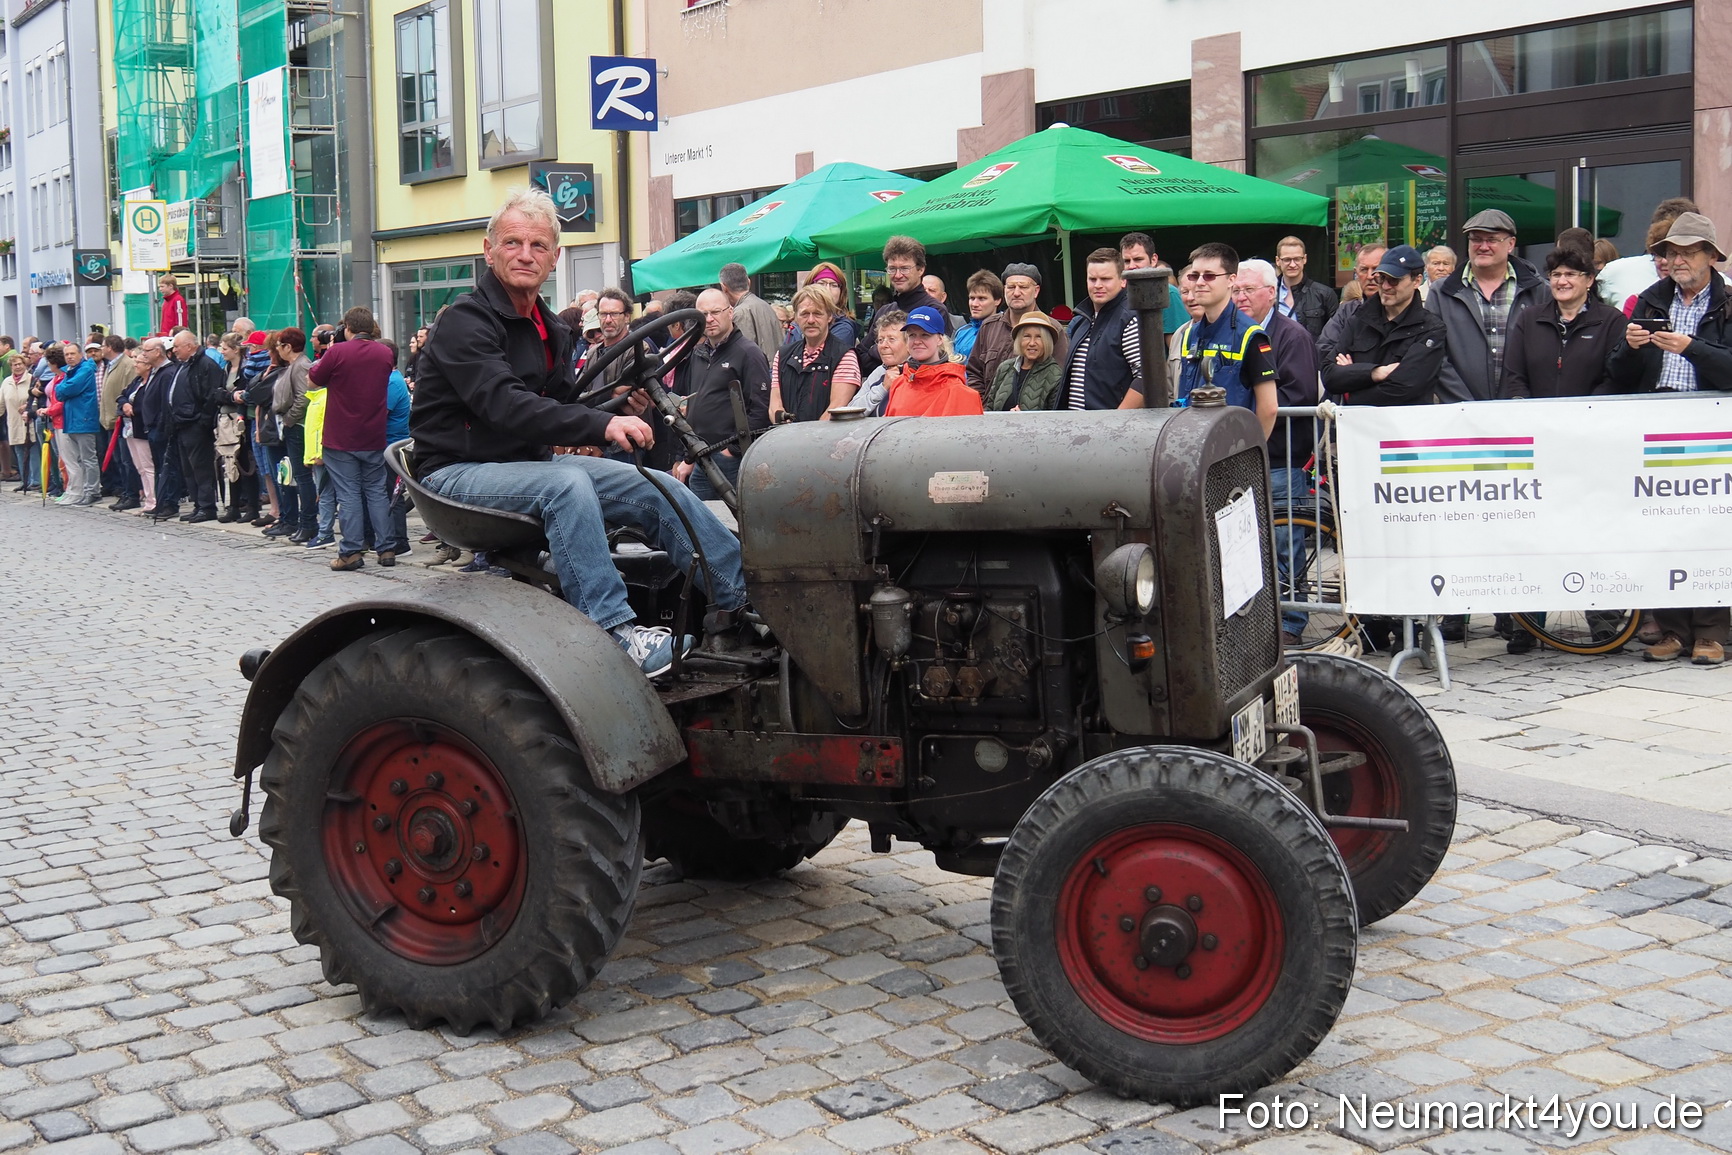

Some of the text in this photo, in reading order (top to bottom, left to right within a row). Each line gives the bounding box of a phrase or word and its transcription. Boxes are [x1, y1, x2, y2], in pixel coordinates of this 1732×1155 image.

[664, 144, 713, 165] Unterer Markt 15
[556, 181, 579, 210] G2
[1117, 184, 1240, 195] Lammsbräu
[890, 197, 997, 219] Lammsbräu
[1342, 202, 1381, 212] Wald- und
[1346, 212, 1376, 221] Wiesen-
[1342, 223, 1379, 231] Kochbuch
[87, 258, 101, 274] G2
[1373, 477, 1543, 504] NeuerMarkt
[1383, 509, 1536, 523] einkaufen leben genießen
[1641, 505, 1701, 517] einkaufen
[1451, 572, 1524, 584] Dammstraße 1
[1590, 570, 1631, 581] Mo.-Sa.
[1692, 567, 1717, 577] über
[1451, 586, 1501, 597] Neumarkt
[1522, 584, 1543, 595] OPf.
[1590, 582, 1645, 594] 10-20 Uhr
[1239, 710, 1251, 741] NM
